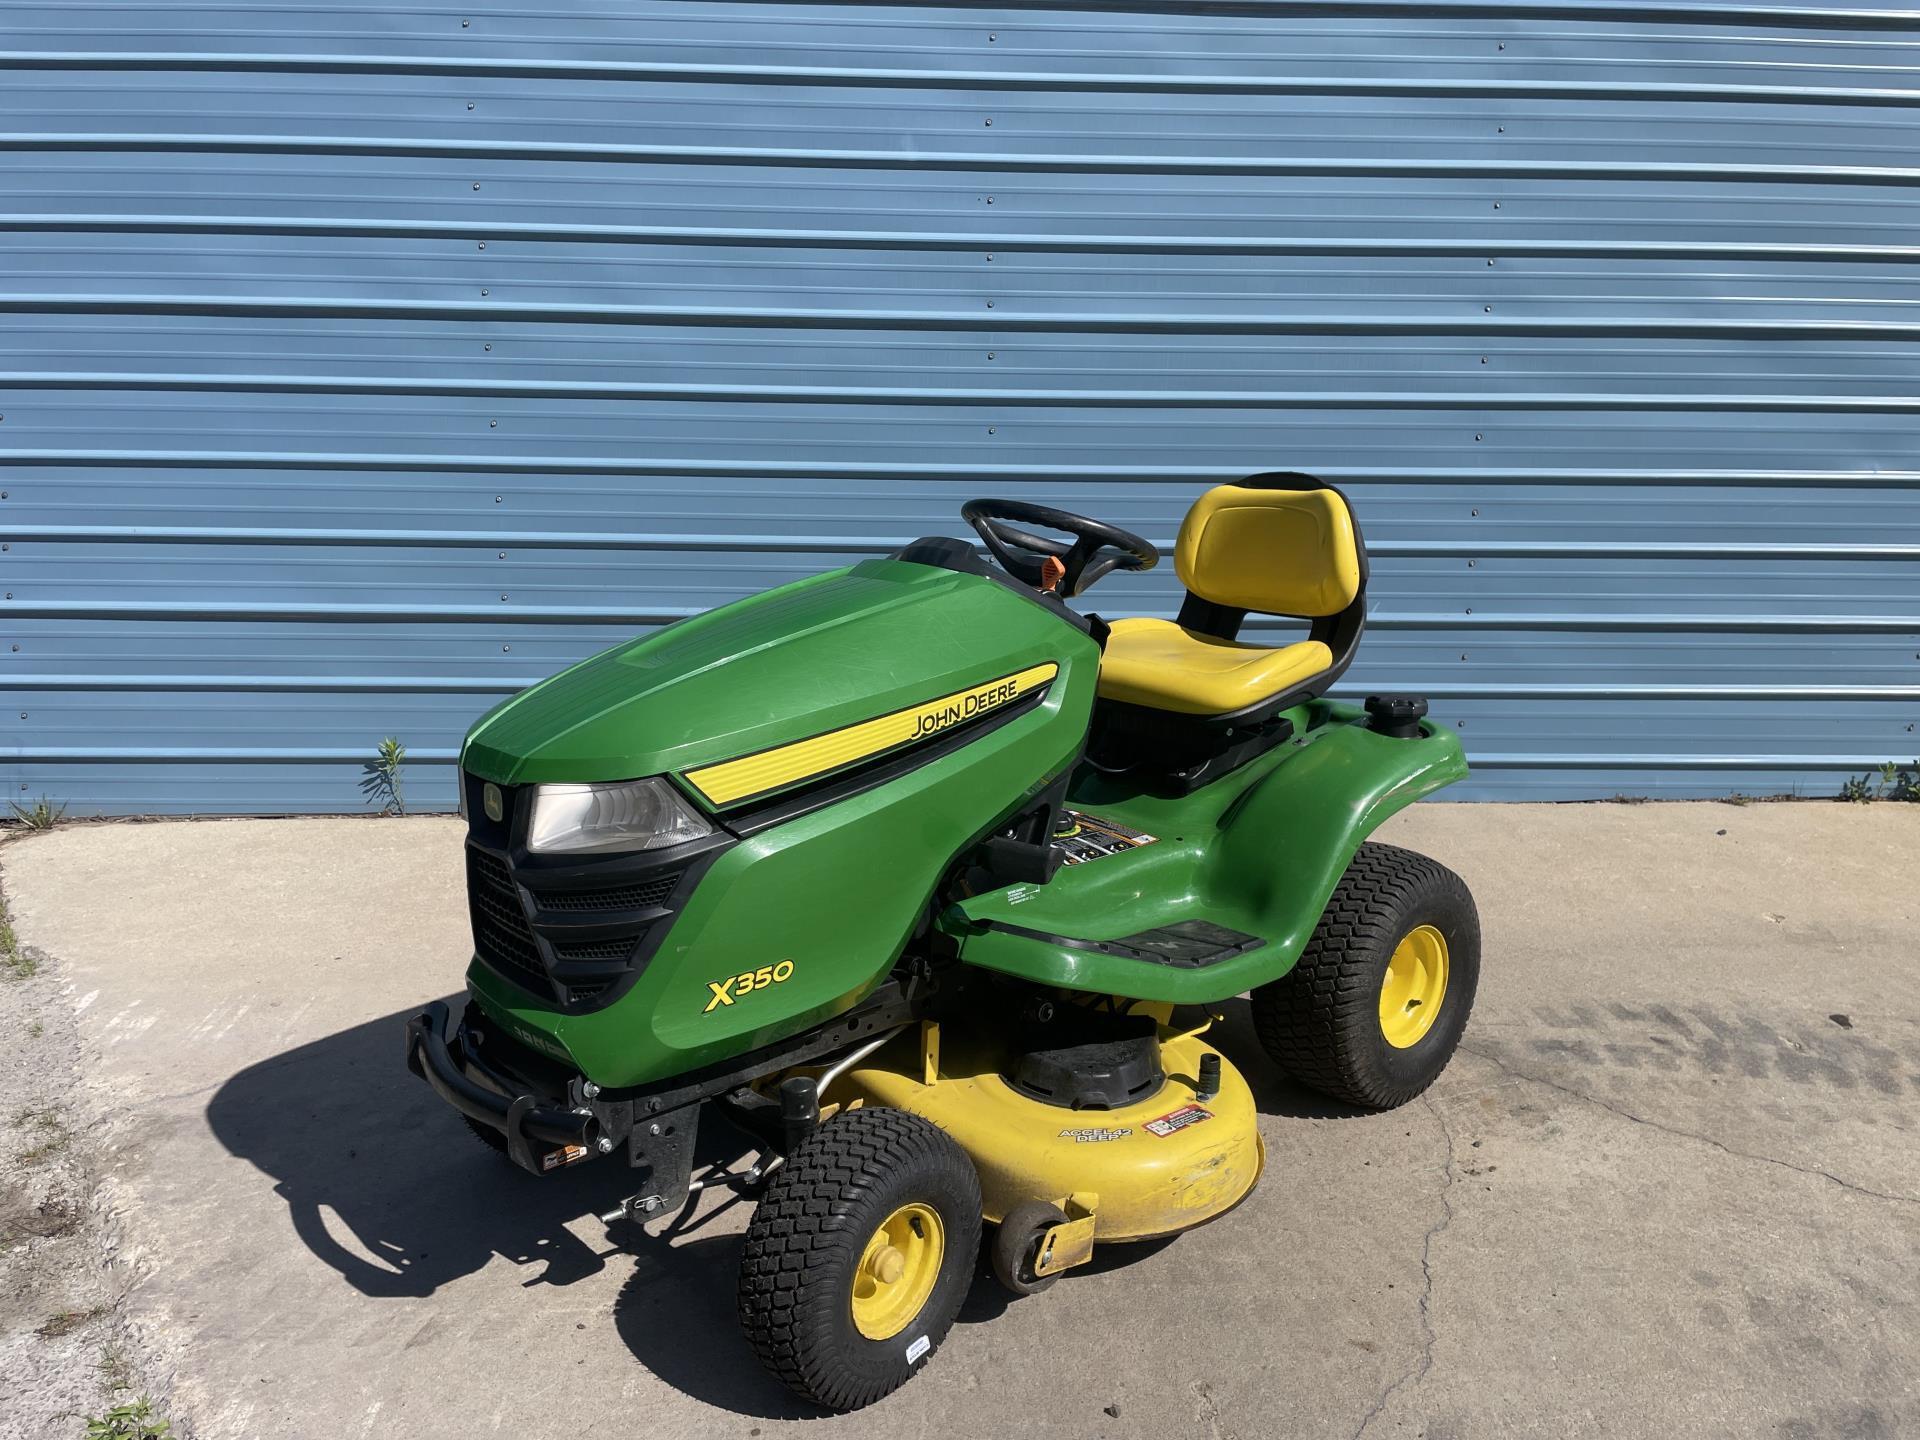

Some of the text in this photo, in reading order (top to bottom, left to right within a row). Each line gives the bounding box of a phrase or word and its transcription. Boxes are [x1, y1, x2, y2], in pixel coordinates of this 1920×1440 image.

[911, 680, 1015, 738] JOHN DEERE
[701, 959, 795, 1014] X350
[1075, 1134, 1121, 1143] DEEP
